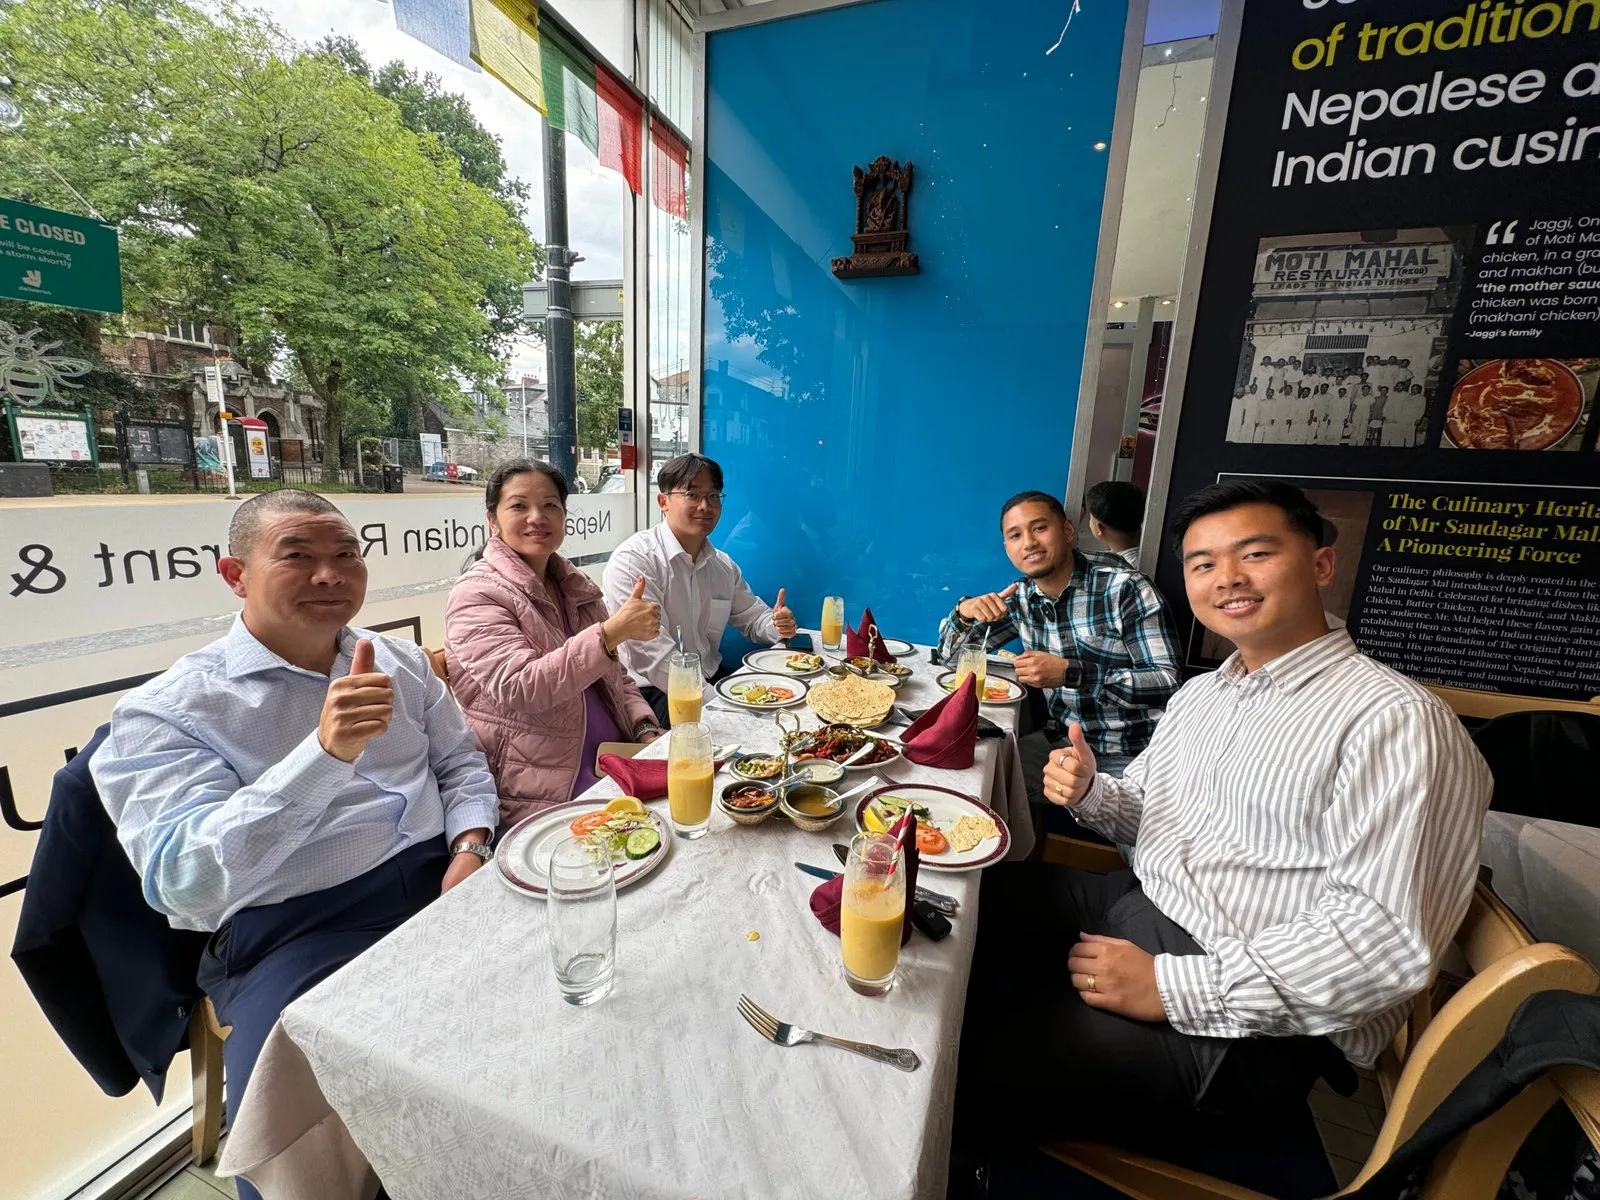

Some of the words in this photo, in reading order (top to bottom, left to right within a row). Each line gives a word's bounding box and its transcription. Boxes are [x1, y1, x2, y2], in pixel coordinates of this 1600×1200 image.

[1292, 22, 1346, 70] of
[1358, 0, 1600, 61] tradition
[1282, 71, 1546, 136] Nepalese
[1272, 138, 1436, 187] Indian
[15, 218, 85, 245] CLOSED
[1529, 217, 1573, 232] Jaggi,
[1526, 235, 1541, 246] of
[1544, 233, 1576, 244] Moti
[6, 250, 36, 260] storm
[39, 256, 71, 269] shortly
[32, 247, 71, 261] cooking
[1265, 252, 1329, 271] MOTI
[1345, 249, 1439, 269] MAHAL
[1482, 252, 1539, 263] chicken,
[1544, 250, 1556, 260] in
[1561, 250, 1572, 259] a
[1479, 267, 1508, 278] and
[1511, 265, 1572, 277] makhan
[1334, 280, 1371, 288] INDIAN
[1509, 281, 1565, 292] mother
[1472, 297, 1525, 308] chicken
[1530, 297, 1559, 306] was
[1563, 295, 1598, 305] born
[1469, 311, 1536, 325] (makhani
[1509, 329, 1543, 338] family
[1389, 493, 1426, 510] The
[1432, 495, 1530, 518] Culinary
[1383, 515, 1406, 530] of
[1408, 517, 1440, 533] Mr
[1444, 519, 1548, 541] Saudagar
[1377, 537, 1392, 551] A
[1397, 538, 1513, 563] Pioneering
[1517, 546, 1581, 564] Force
[1373, 564, 1391, 572] Our
[1393, 566, 1430, 576] culinary
[1433, 569, 1483, 580] philosophy
[1486, 572, 1493, 580] is
[1497, 573, 1529, 583] deeply
[1531, 577, 1564, 586] rooted
[1567, 578, 1576, 586] in
[1580, 579, 1596, 587] the
[1368, 586, 1395, 594] Mahal
[1398, 587, 1407, 595] in
[1438, 592, 1488, 601] Celebrated
[1507, 596, 1549, 608] bringing
[1552, 601, 1584, 610] dishes
[1387, 576, 1429, 586] Saudagar
[1451, 581, 1502, 592] introduced
[1505, 585, 1515, 593] to
[1537, 588, 1552, 596] UK
[1554, 589, 1579, 598] from
[1582, 591, 1599, 599] the
[1406, 600, 1435, 608] Butter
[1480, 606, 1496, 614] Dal
[1361, 618, 1413, 629] establishing
[1416, 622, 1438, 630] them
[1454, 627, 1486, 635] staples
[1501, 630, 1532, 639] Indian
[1535, 634, 1570, 643] cuisine
[1435, 613, 1449, 621] Mr.
[1472, 616, 1504, 626] helped
[1507, 619, 1532, 628] these
[1535, 622, 1568, 632] flavors
[1570, 626, 1593, 634] gain
[1359, 627, 1377, 635] This
[1380, 629, 1407, 639] legacy
[1436, 634, 1484, 646] foundation
[1500, 641, 1517, 649] The
[1520, 643, 1561, 654] Original
[1564, 647, 1592, 657] Third
[1424, 644, 1465, 655] profound
[1468, 649, 1511, 659] influence
[1514, 655, 1561, 665] continues
[1424, 655, 1456, 665] infuses
[1460, 658, 1509, 671] traditional
[1511, 665, 1554, 676] Nepalese
[1556, 670, 1576, 678] and
[1423, 667, 1465, 677] authentic
[1467, 670, 1485, 679] and
[1488, 673, 1536, 685] innovative
[1539, 680, 1581, 691] culinary
[1584, 684, 1600, 692] tec
